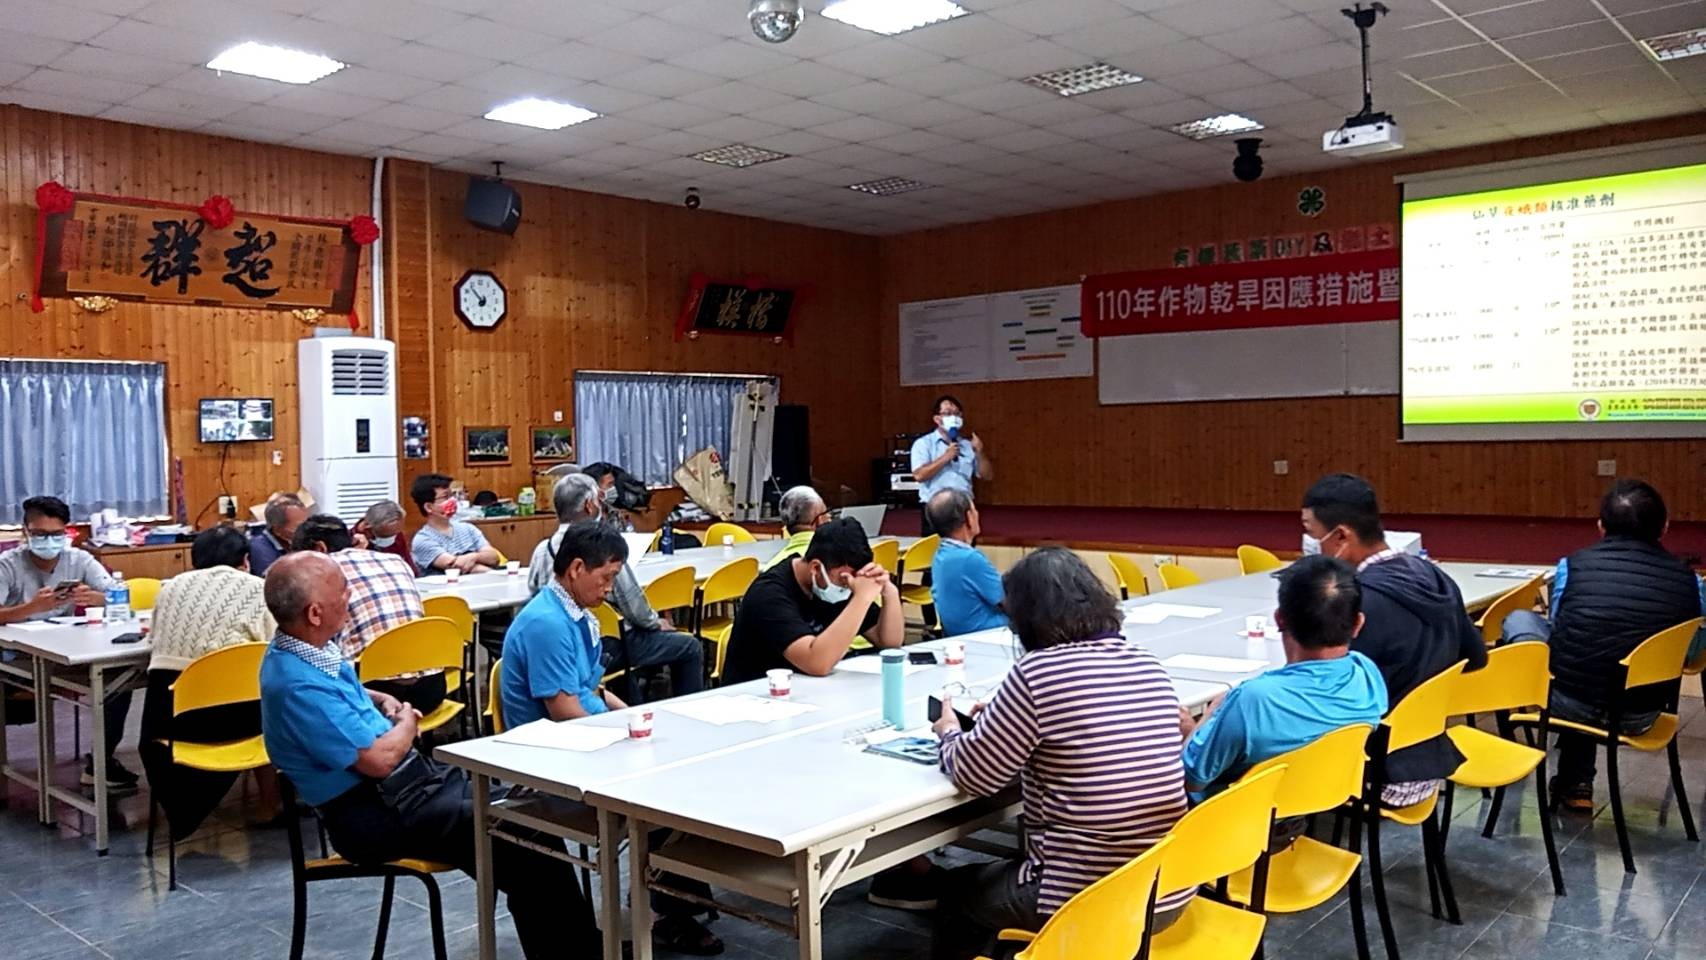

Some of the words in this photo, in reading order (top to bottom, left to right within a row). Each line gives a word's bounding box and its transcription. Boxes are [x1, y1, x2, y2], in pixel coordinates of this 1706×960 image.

[1096, 267, 1401, 320] 110年作物乾旱因應措施暨
